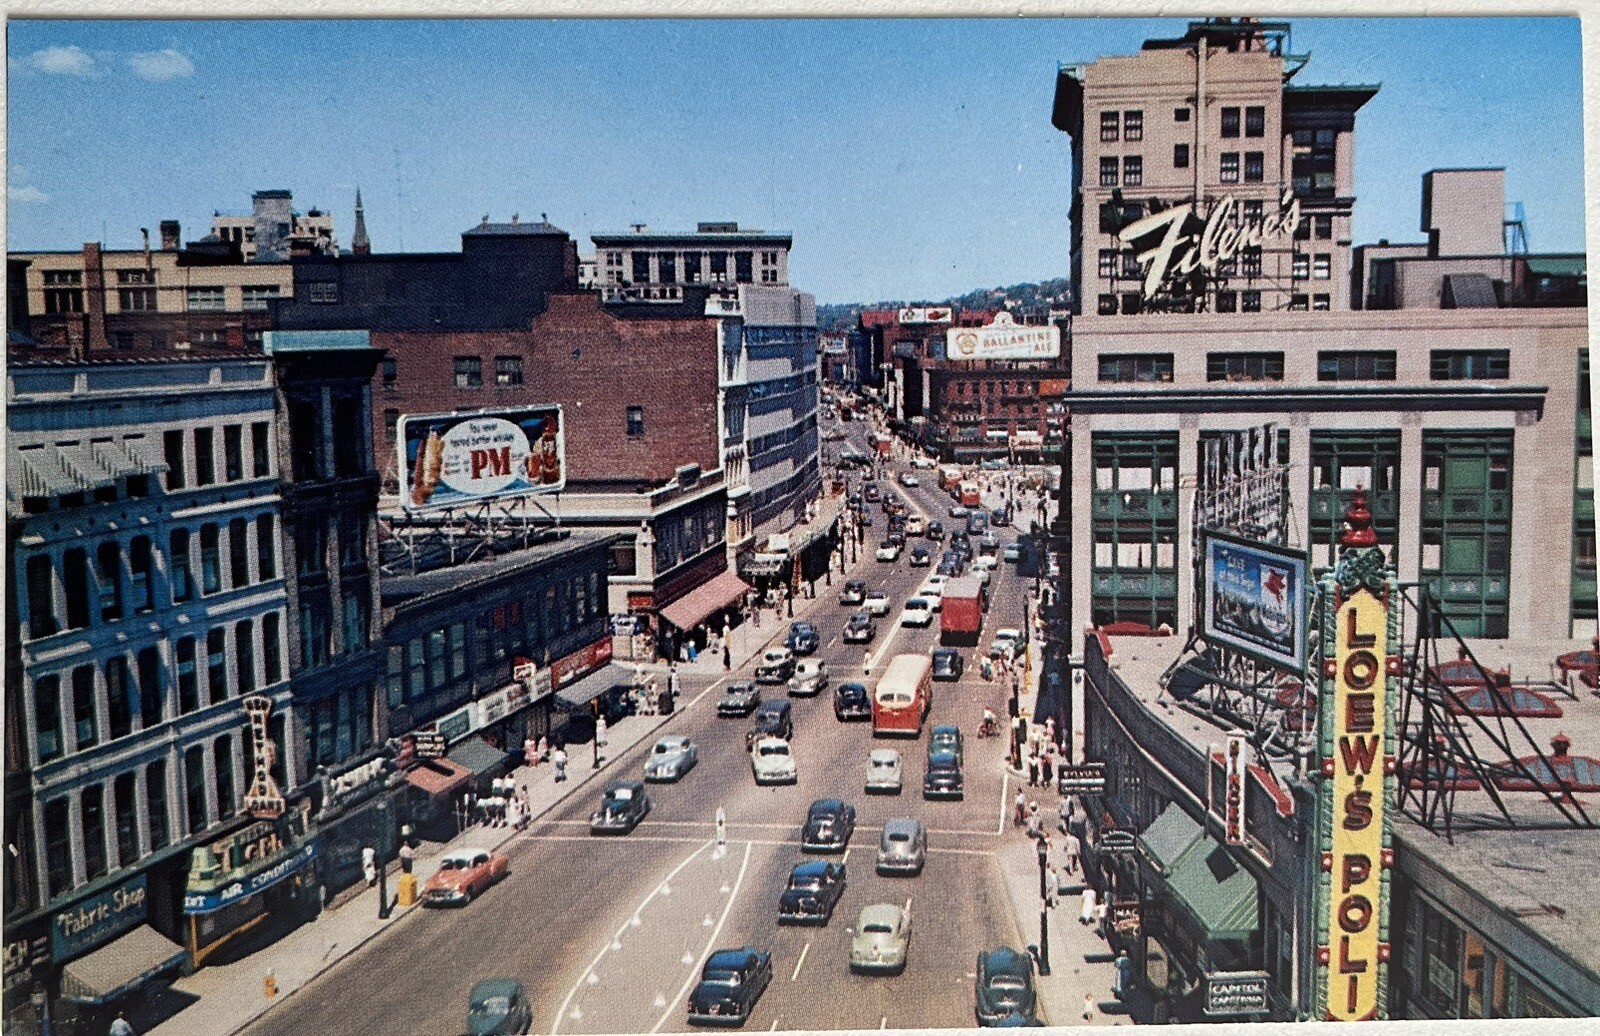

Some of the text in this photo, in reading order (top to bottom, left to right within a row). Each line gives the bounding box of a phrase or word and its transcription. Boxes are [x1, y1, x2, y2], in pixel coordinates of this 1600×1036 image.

[1118, 189, 1301, 300] Filene's
[984, 332, 1052, 347] BALLANTINE
[1034, 342, 1052, 353] ALE
[470, 446, 512, 479] PM
[1337, 607, 1380, 1014] LOEW'S POLI
[221, 882, 243, 900] AIR
[57, 901, 110, 937] Fabric
[113, 886, 147, 912] Shop
[1212, 984, 1262, 996] CAPITOL
